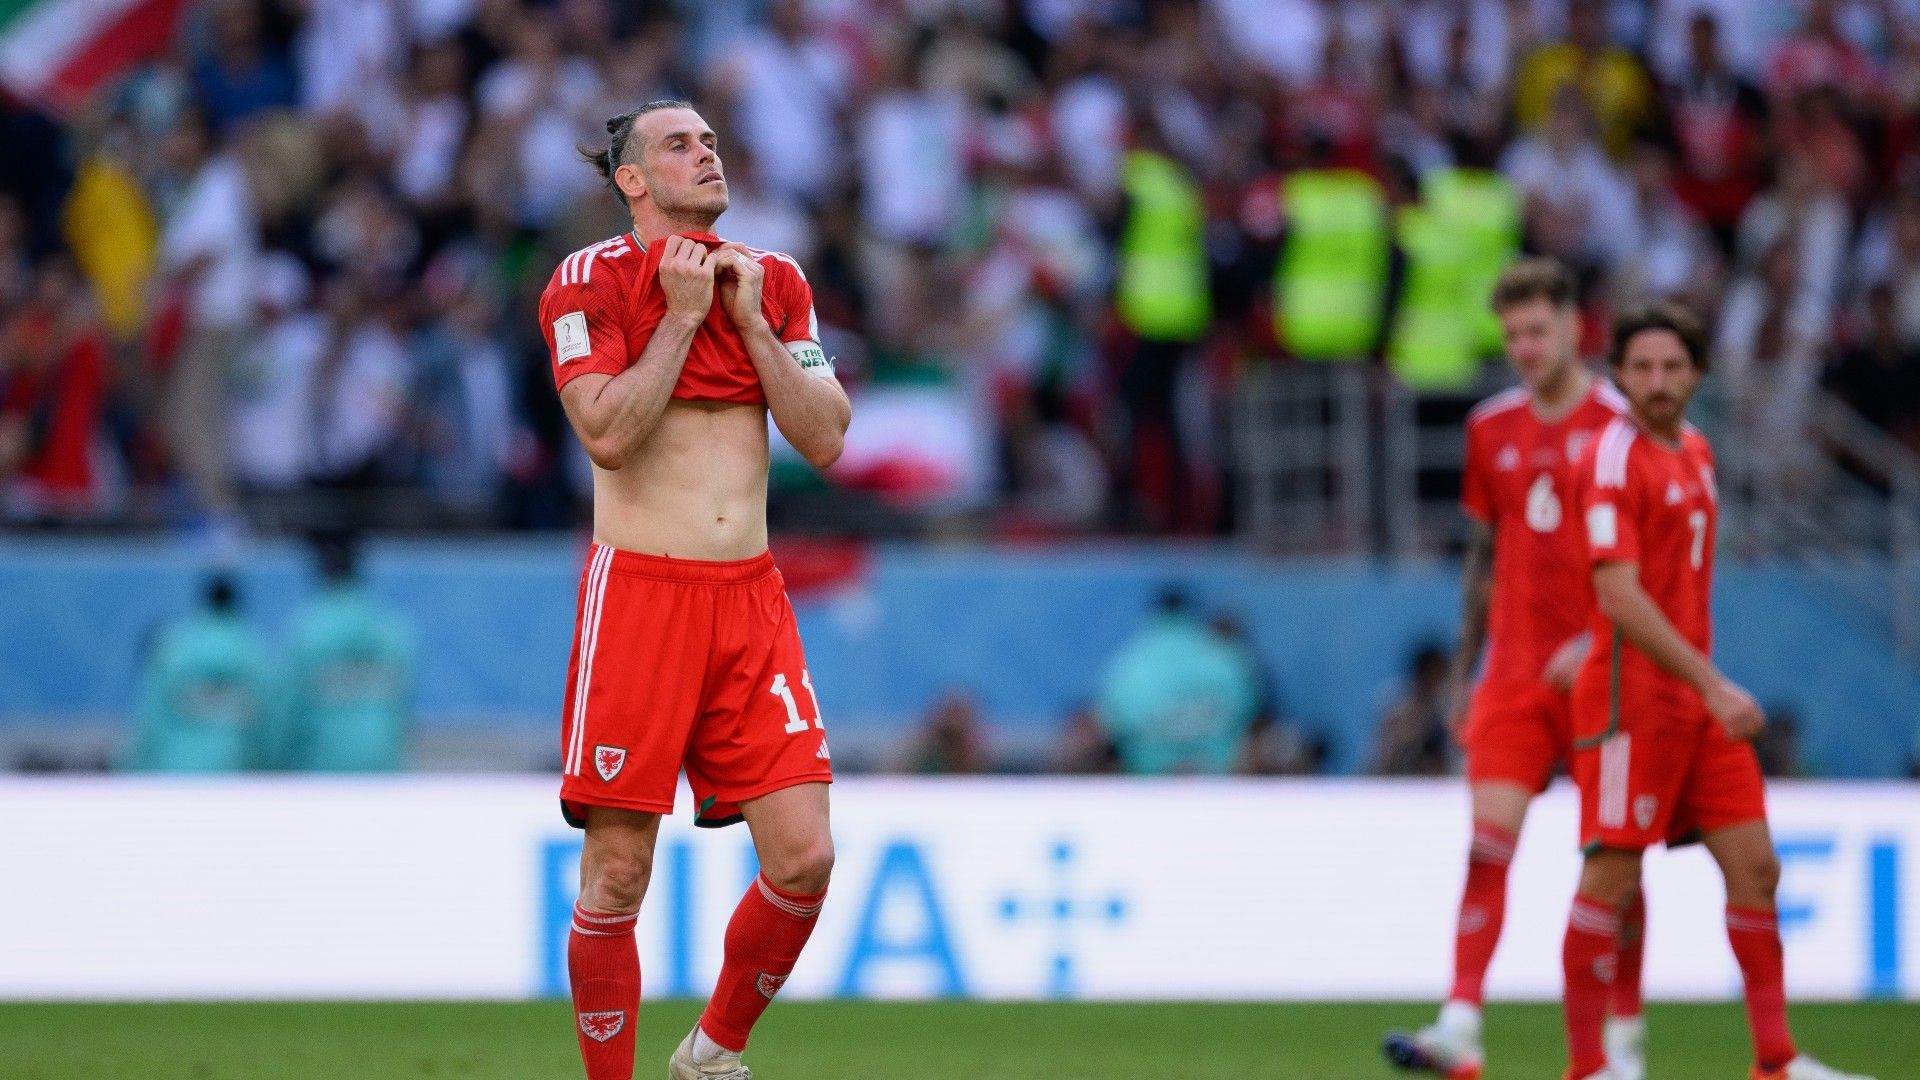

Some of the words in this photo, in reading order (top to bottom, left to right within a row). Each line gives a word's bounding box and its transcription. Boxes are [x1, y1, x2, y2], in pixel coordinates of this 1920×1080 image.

[1525, 472, 1563, 533] 6
[770, 669, 825, 734] 11
[541, 837, 1128, 999] FIA+
